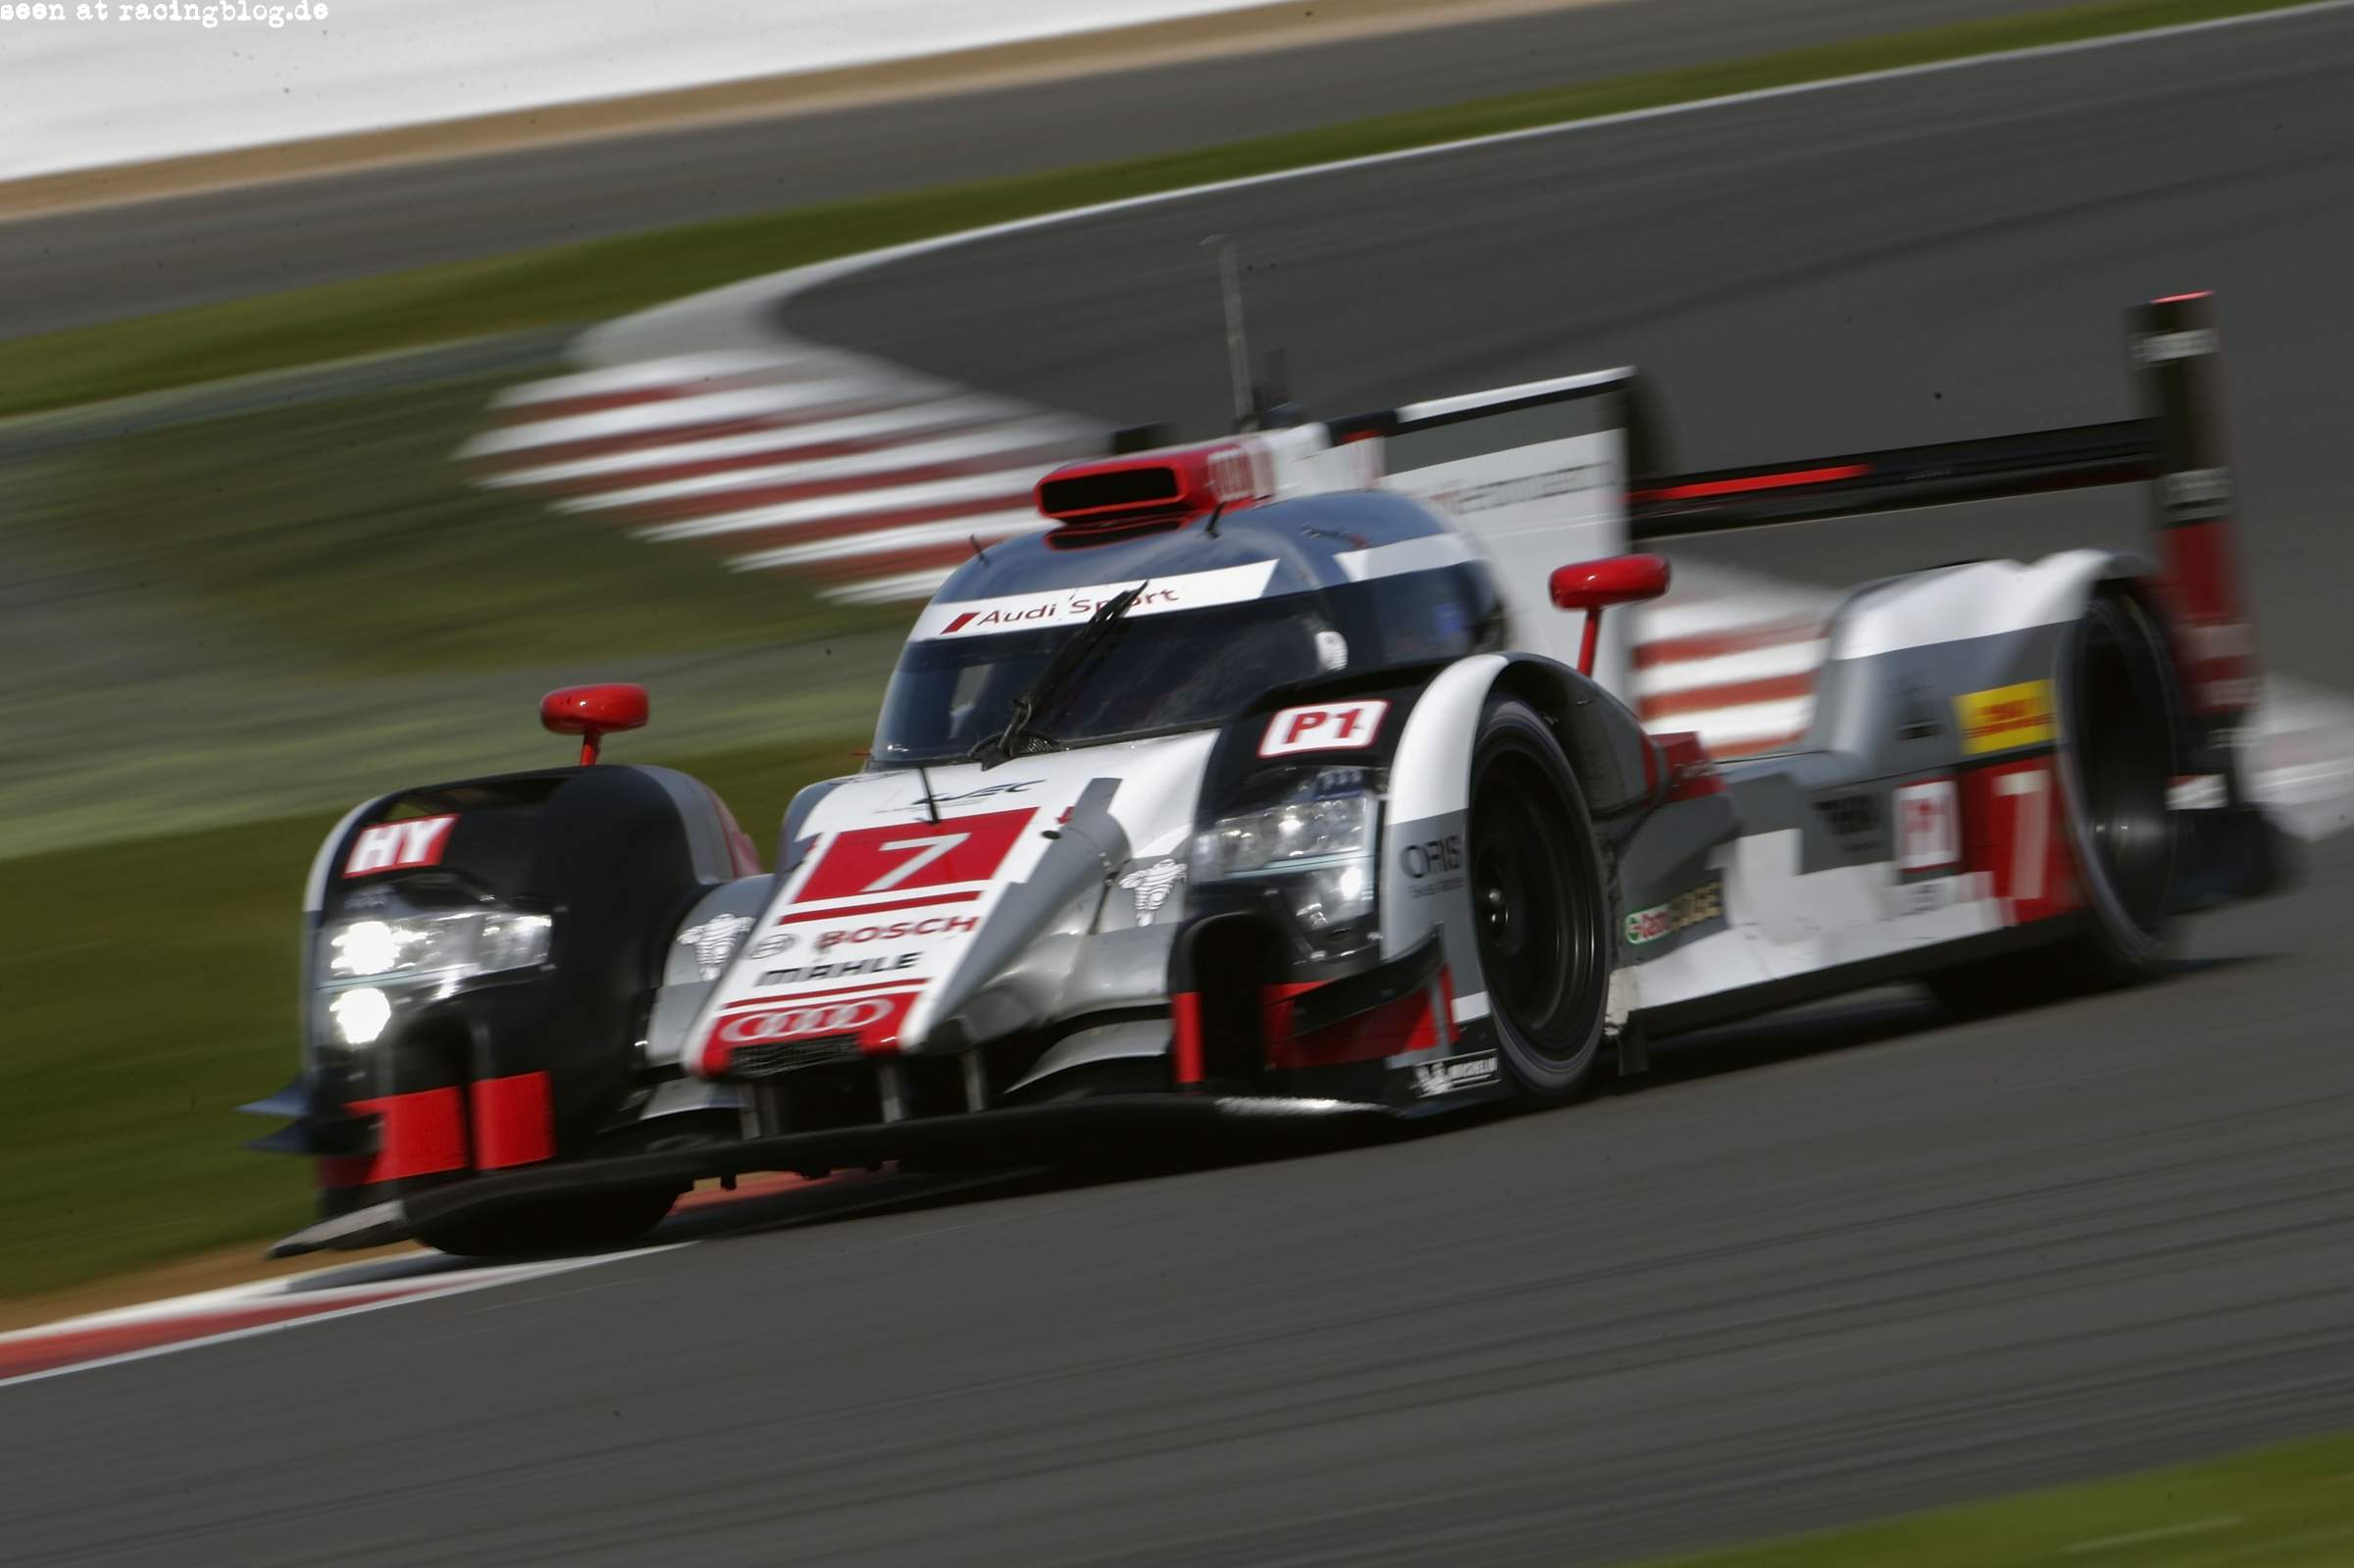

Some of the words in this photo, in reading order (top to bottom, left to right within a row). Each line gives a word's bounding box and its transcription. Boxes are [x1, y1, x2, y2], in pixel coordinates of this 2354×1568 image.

[977, 604, 1056, 626] Audi
[1282, 707, 1363, 744] P1
[344, 816, 456, 874] HY
[1991, 769, 2053, 900] 7
[859, 832, 972, 892] 7
[815, 916, 981, 948] BOSCH
[754, 951, 924, 987] MAHLE
